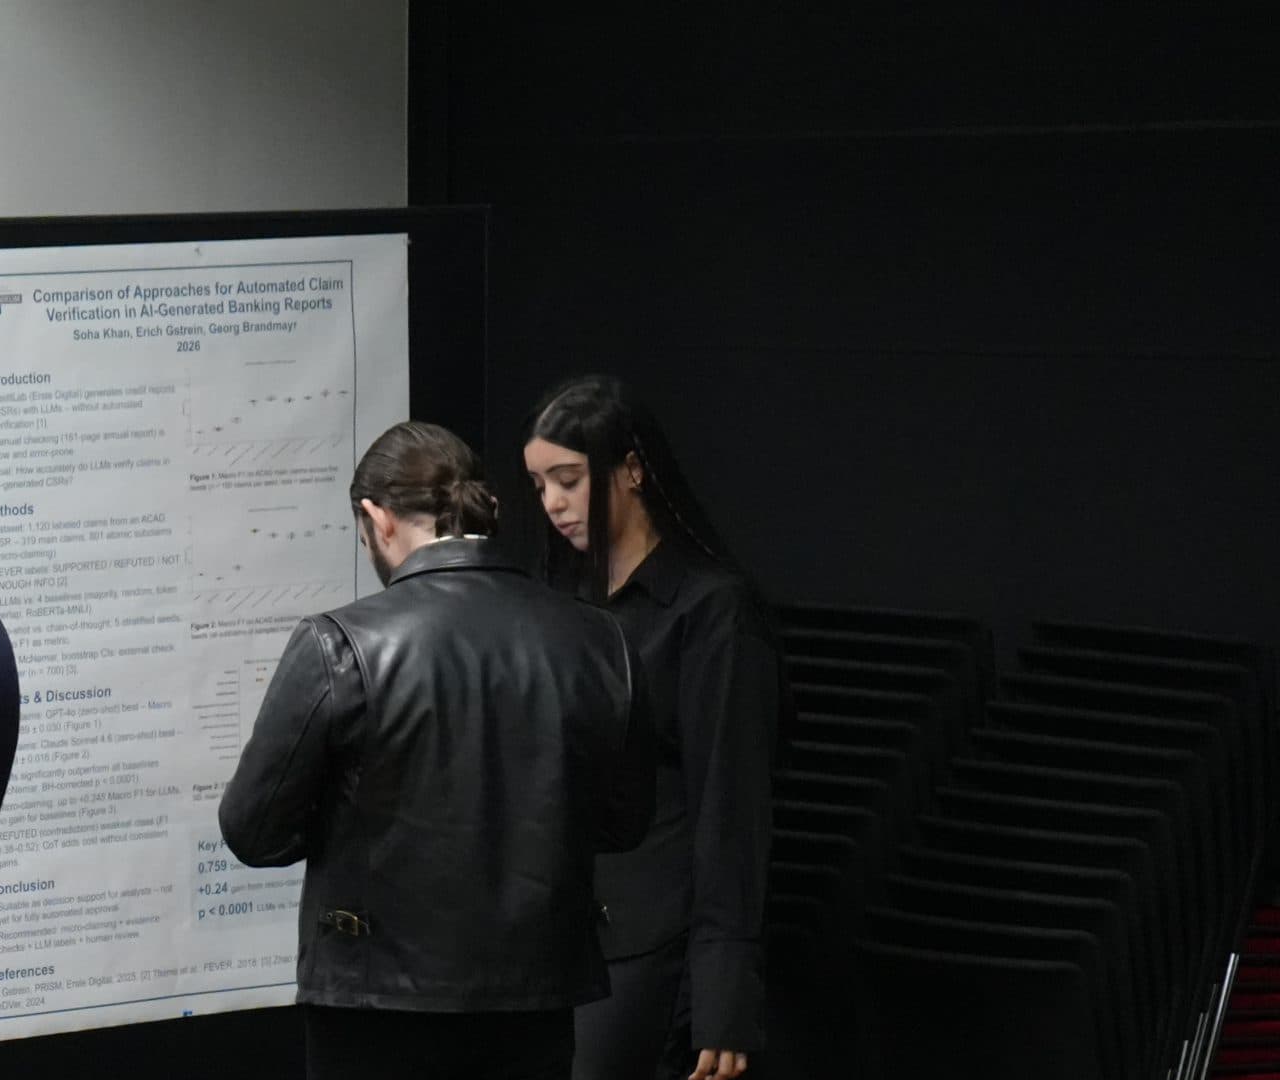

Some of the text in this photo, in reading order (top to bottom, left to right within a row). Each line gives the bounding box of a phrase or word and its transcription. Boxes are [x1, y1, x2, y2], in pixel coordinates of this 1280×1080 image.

[32, 288, 113, 303] Comparison
[116, 284, 130, 299] of
[133, 283, 210, 301] Approaches
[214, 281, 233, 295] for
[236, 278, 305, 294] Automated
[308, 277, 343, 291] Claim
[45, 297, 332, 321] Verification in AI-Generated Banking Reports
[102, 327, 133, 339] Khan,
[176, 340, 200, 352] 2026
[34, 686, 112, 704] & Discussion
[197, 840, 217, 852] Key
[197, 859, 227, 874] 0.759
[197, 882, 228, 895] +0.24
[218, 901, 253, 916] 0.0001
